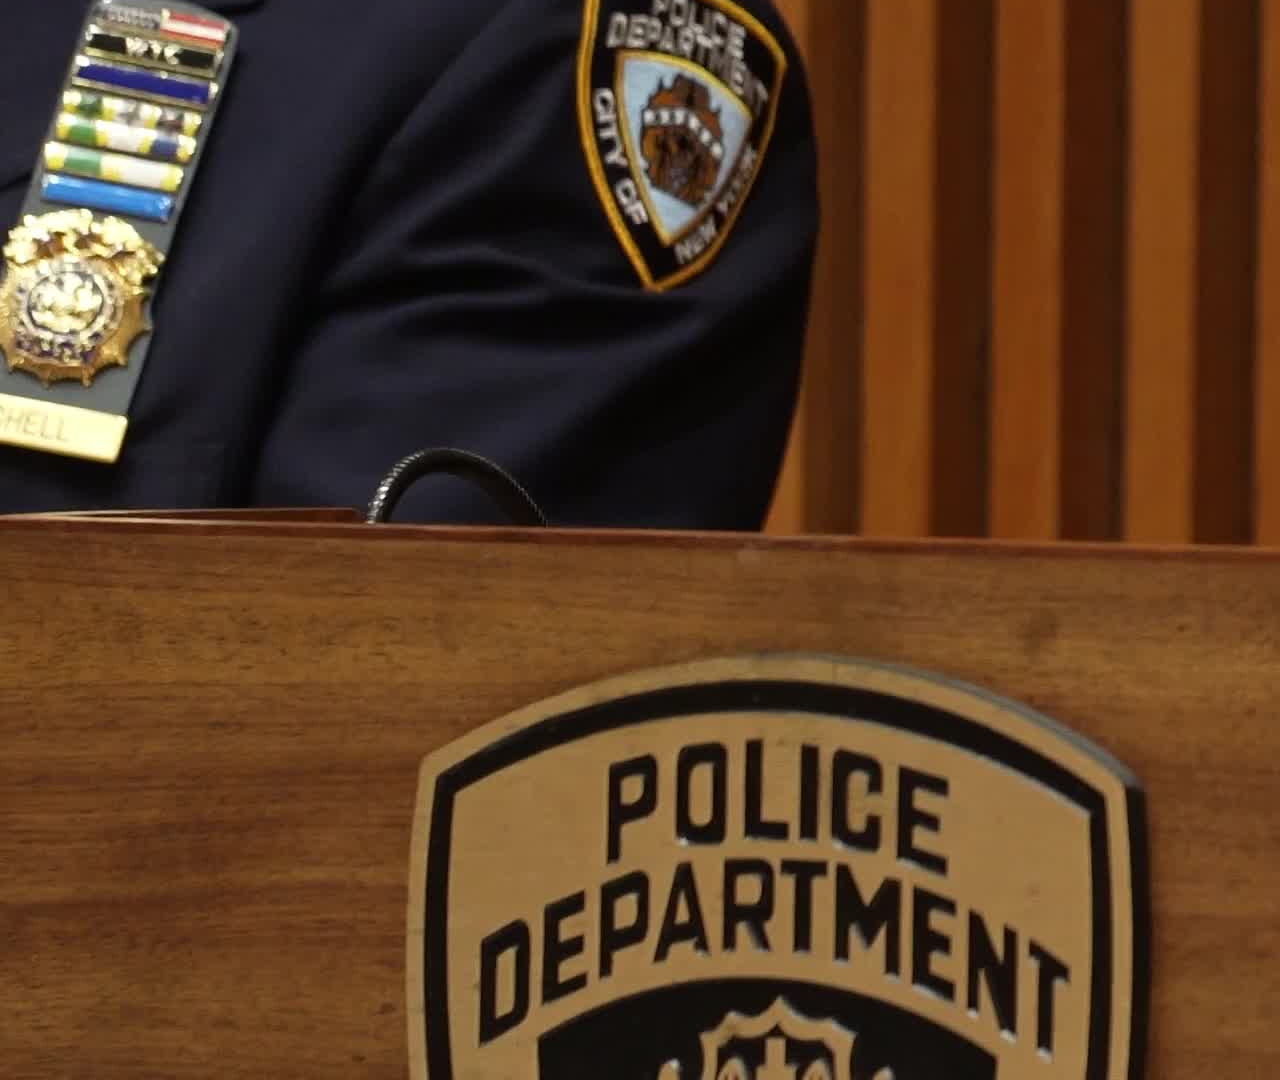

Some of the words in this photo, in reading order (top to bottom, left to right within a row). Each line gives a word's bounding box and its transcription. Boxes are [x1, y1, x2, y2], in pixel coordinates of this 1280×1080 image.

[593, 86, 629, 168] CITY
[615, 177, 649, 226] OF
[606, 738, 950, 877] POLICE
[477, 857, 1070, 1064] DEPARTMENT
